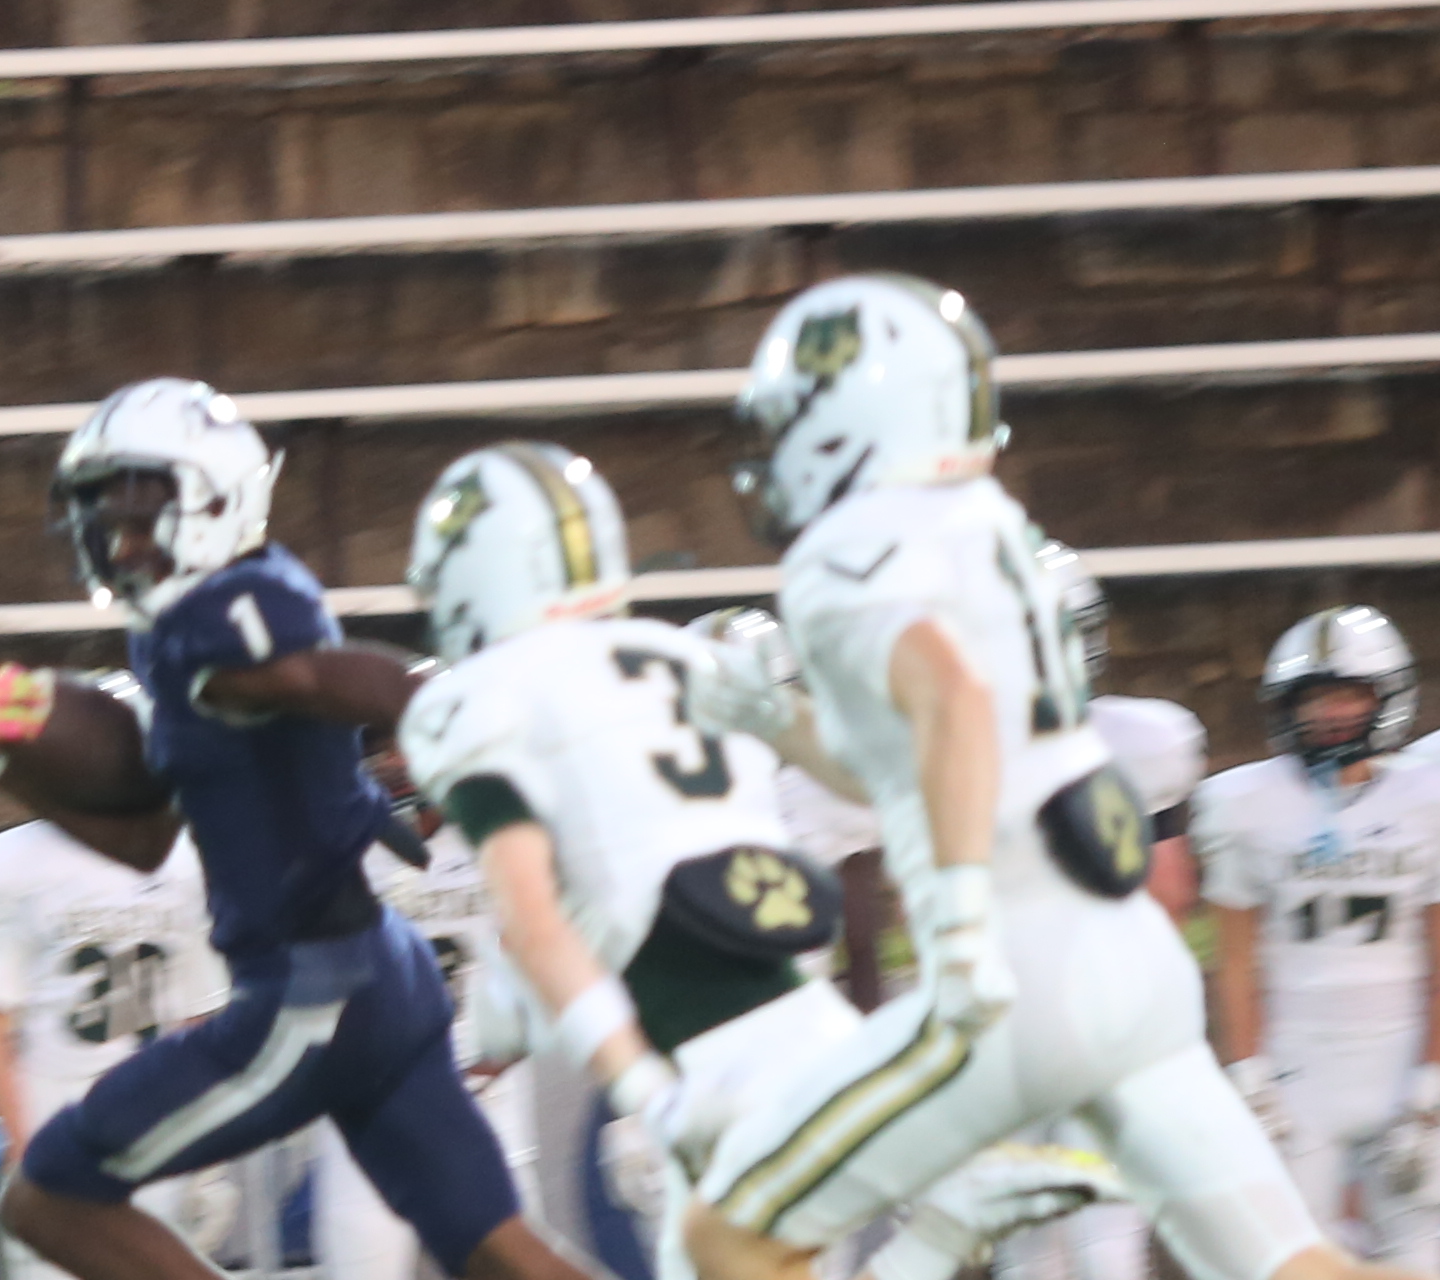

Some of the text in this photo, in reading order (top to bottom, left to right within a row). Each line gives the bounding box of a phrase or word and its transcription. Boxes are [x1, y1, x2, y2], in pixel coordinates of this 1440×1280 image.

[226, 592, 274, 662] 1
[996, 525, 1092, 736] 1
[611, 645, 735, 801] 3
